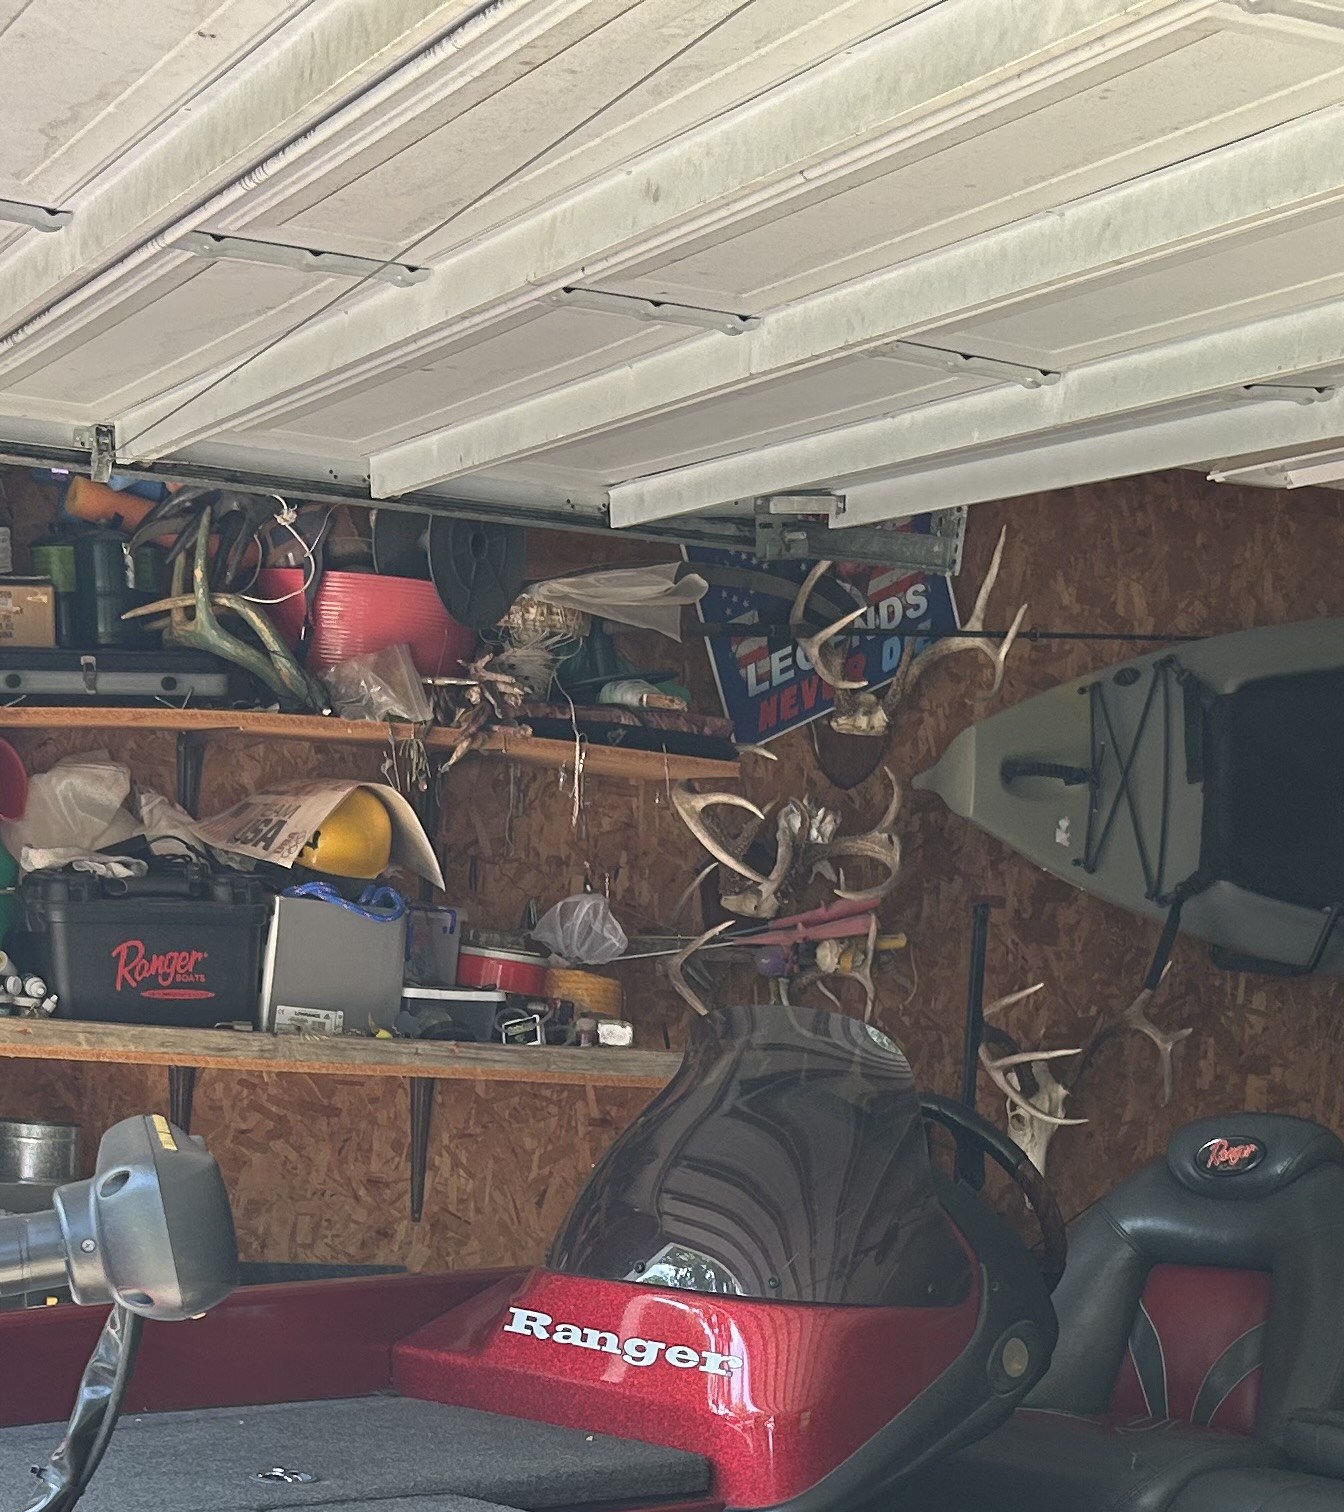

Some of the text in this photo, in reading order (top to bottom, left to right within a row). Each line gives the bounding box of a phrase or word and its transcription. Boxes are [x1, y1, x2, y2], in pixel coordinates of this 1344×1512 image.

[746, 583, 928, 697] LENDS
[758, 654, 867, 732] NEVR
[112, 940, 204, 991] Ranger
[176, 974, 206, 983] BOATS
[504, 1307, 743, 1376] Ranger
